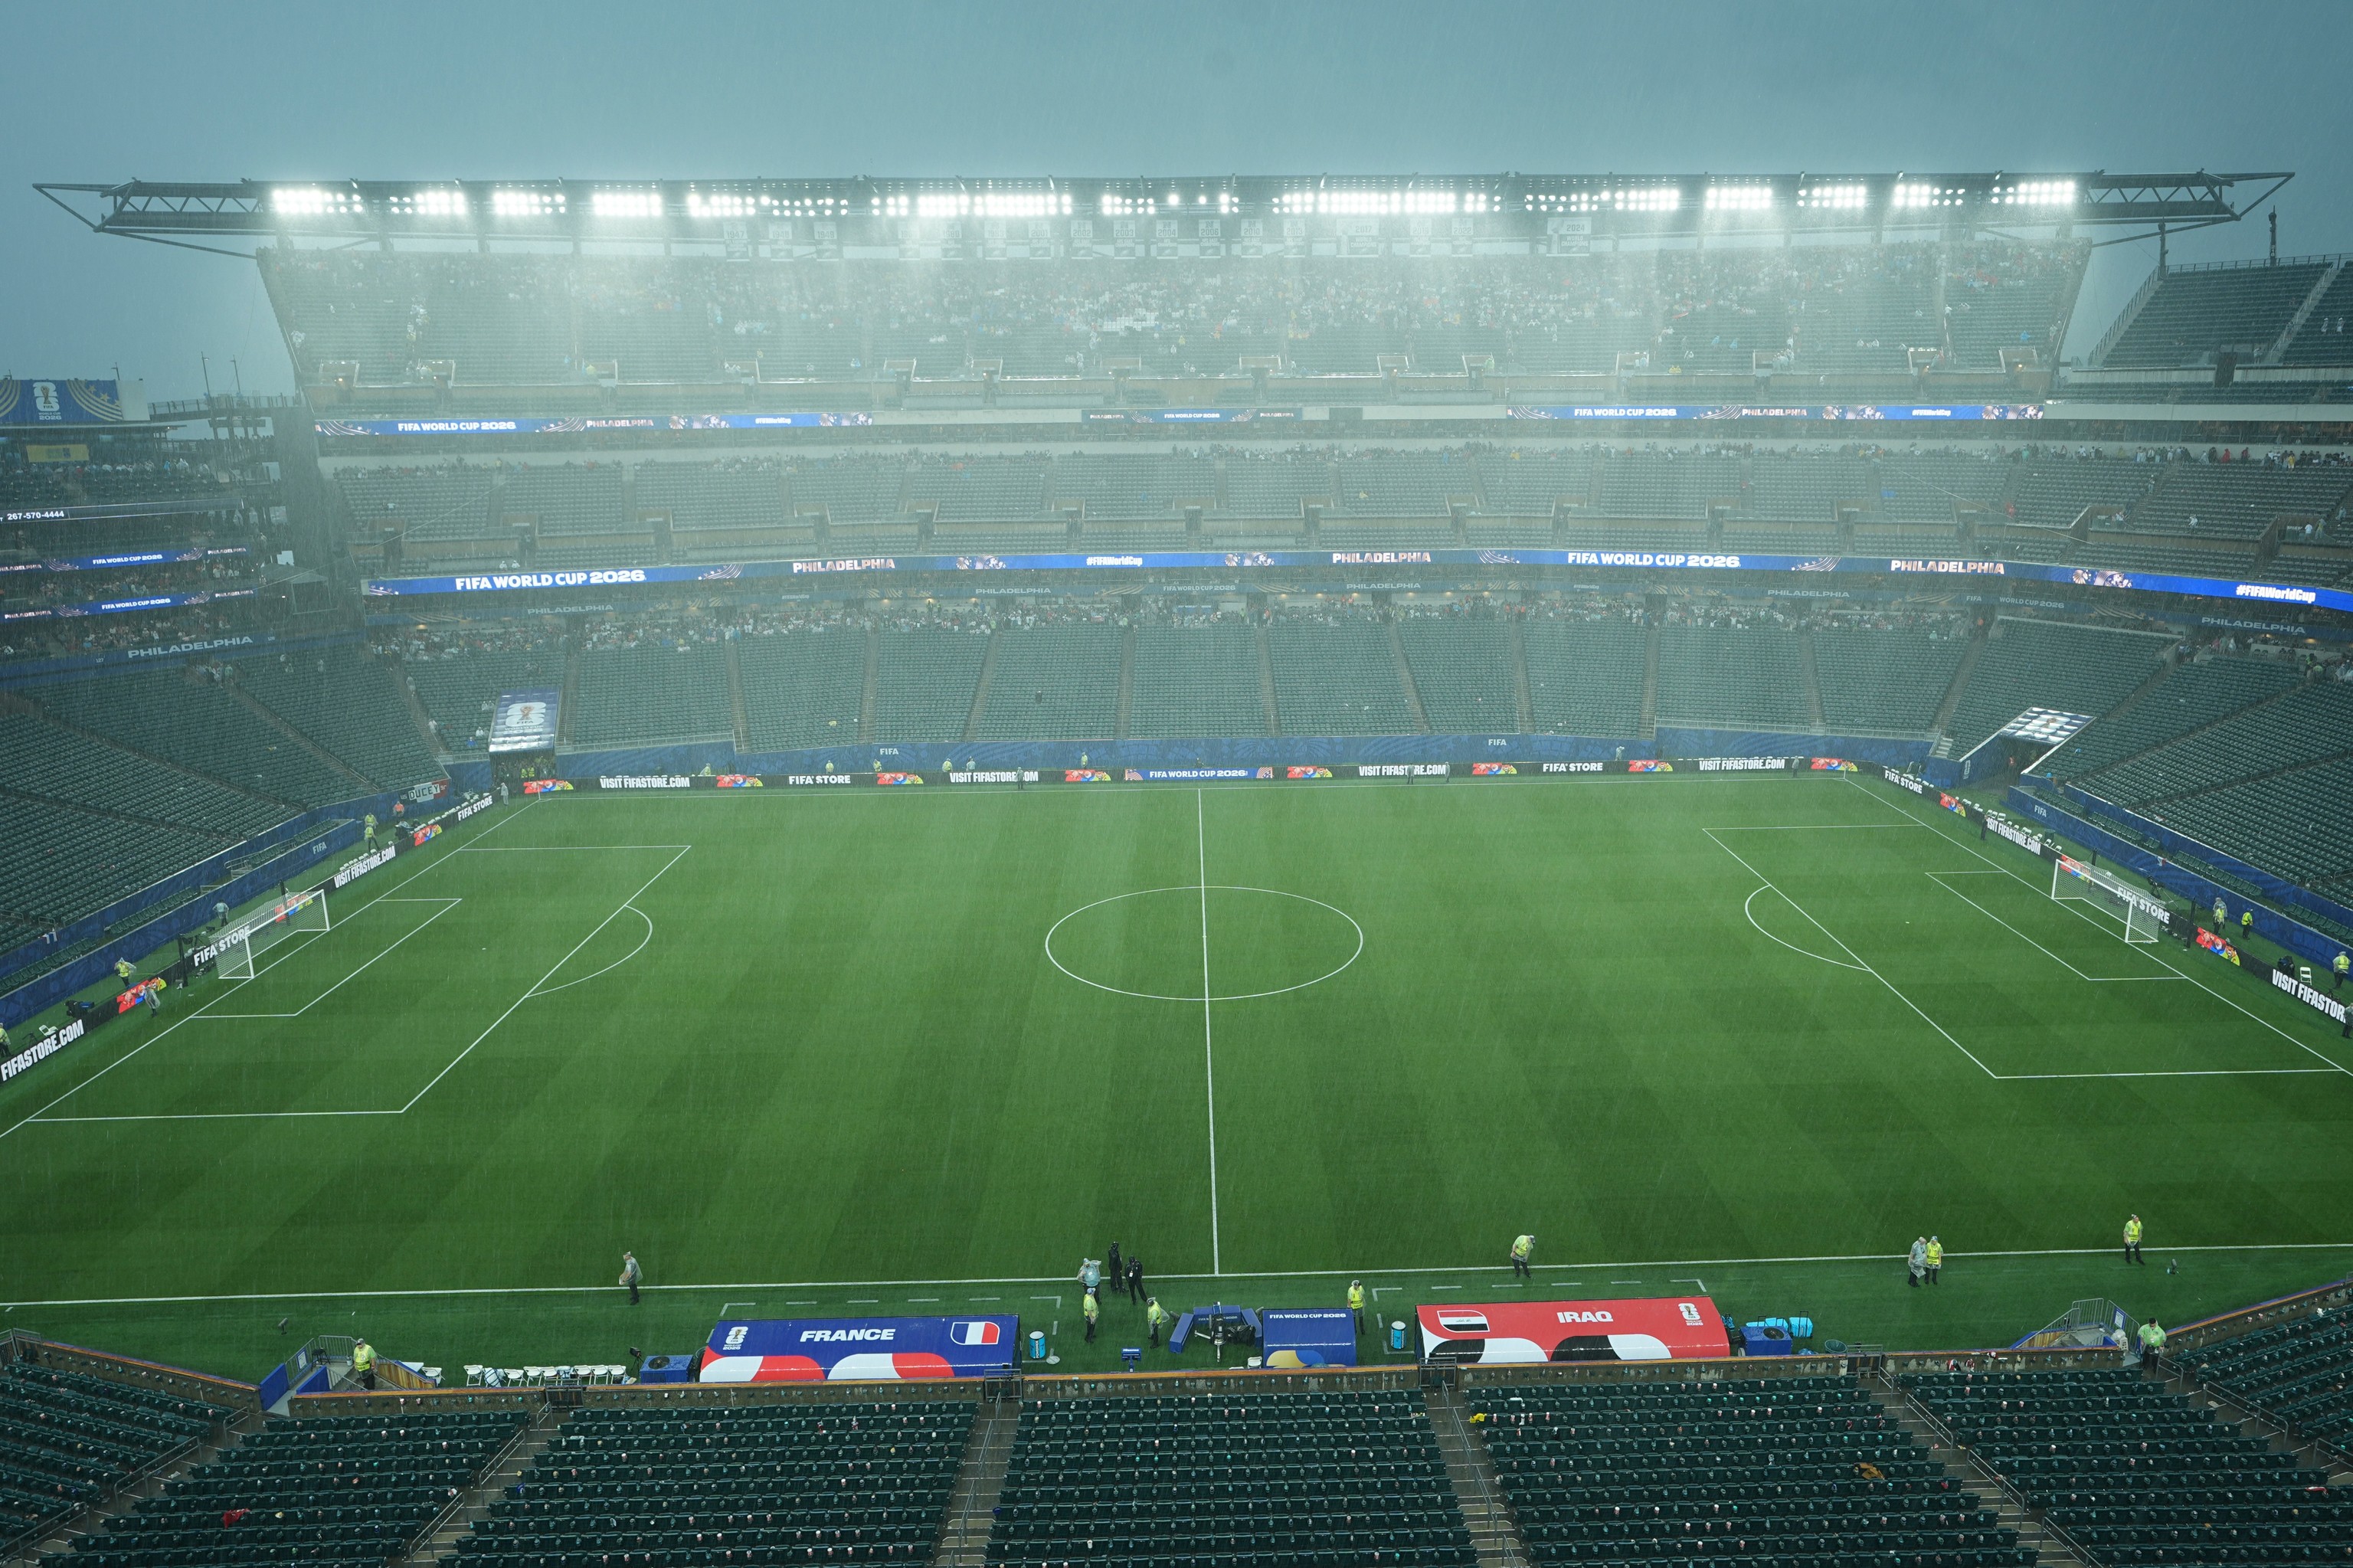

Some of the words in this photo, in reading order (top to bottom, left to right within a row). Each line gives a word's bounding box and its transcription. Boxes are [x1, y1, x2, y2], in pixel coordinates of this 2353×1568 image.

[1157, 228, 1176, 237] 2004
[1574, 408, 1594, 417] FIFA
[1594, 408, 1625, 417] WORLD
[1742, 408, 1807, 417] PHILADELPHIA
[398, 423, 421, 431] FIFA
[421, 422, 458, 431] WORLD
[460, 422, 479, 430] CUP
[480, 421, 516, 430] 2026
[586, 419, 654, 428] PHILADELPHIA
[7, 511, 64, 521] 267-570-4444
[1086, 556, 1143, 567] #FIFAWorldCup
[1332, 552, 1432, 564] PHILADELPHIA
[1567, 552, 1599, 565] FIFA
[1600, 553, 1654, 565] WORLD
[1654, 554, 1686, 567] CUP
[1686, 555, 1740, 568] 2026
[793, 558, 895, 574] PHILADELPHIA
[1890, 559, 2005, 574] PHILADELPHIA
[455, 577, 493, 591] FIFA
[492, 574, 553, 589] WORLD
[555, 571, 587, 585] CUP
[589, 569, 647, 584] 2026
[215, 589, 254, 598] PHILADELPHIA
[1767, 589, 1850, 598] PHILADELPHIA
[2236, 584, 2316, 604] #FIFAWorldCup
[1999, 596, 2024, 605] WORLD
[2039, 601, 2065, 609] 2026
[5, 610, 51, 620] PHILADELPHIA
[527, 604, 614, 615] PHILADELPHIA
[2201, 617, 2306, 635] PHILADELPHIA
[127, 636, 254, 659] PHILADELPHIA
[1359, 766, 1381, 776] VISIT
[1382, 764, 1447, 776] FIFASTRE.COM
[1569, 762, 1603, 771] STORE
[1699, 760, 1721, 771] VISIT
[1721, 759, 1785, 771] FIFASTORE.COM
[600, 778, 624, 789] VISIT
[623, 777, 690, 788] FIFASTORE.COM
[815, 774, 851, 784] STORE
[949, 772, 973, 783] VISIT
[1900, 776, 1923, 794] STORE
[408, 784, 440, 800] DUCEY
[473, 795, 493, 813] STORE
[2034, 804, 2047, 818] FIFA
[1987, 817, 1999, 833] ISIT
[1998, 822, 2041, 856] FIFASTORE.COM
[313, 841, 327, 855] FIFA
[334, 871, 351, 889] VISIT
[350, 846, 396, 880] FIFASTORE.COM
[2138, 895, 2171, 925] STORE
[218, 925, 250, 953] STORE
[2272, 968, 2299, 996] VISIT
[2297, 983, 2346, 1024] FIFASTOR
[0, 1020, 84, 1082] FIFASTORE.COM
[1557, 1311, 1614, 1324] IRAQ
[800, 1328, 896, 1343] FRANCE
